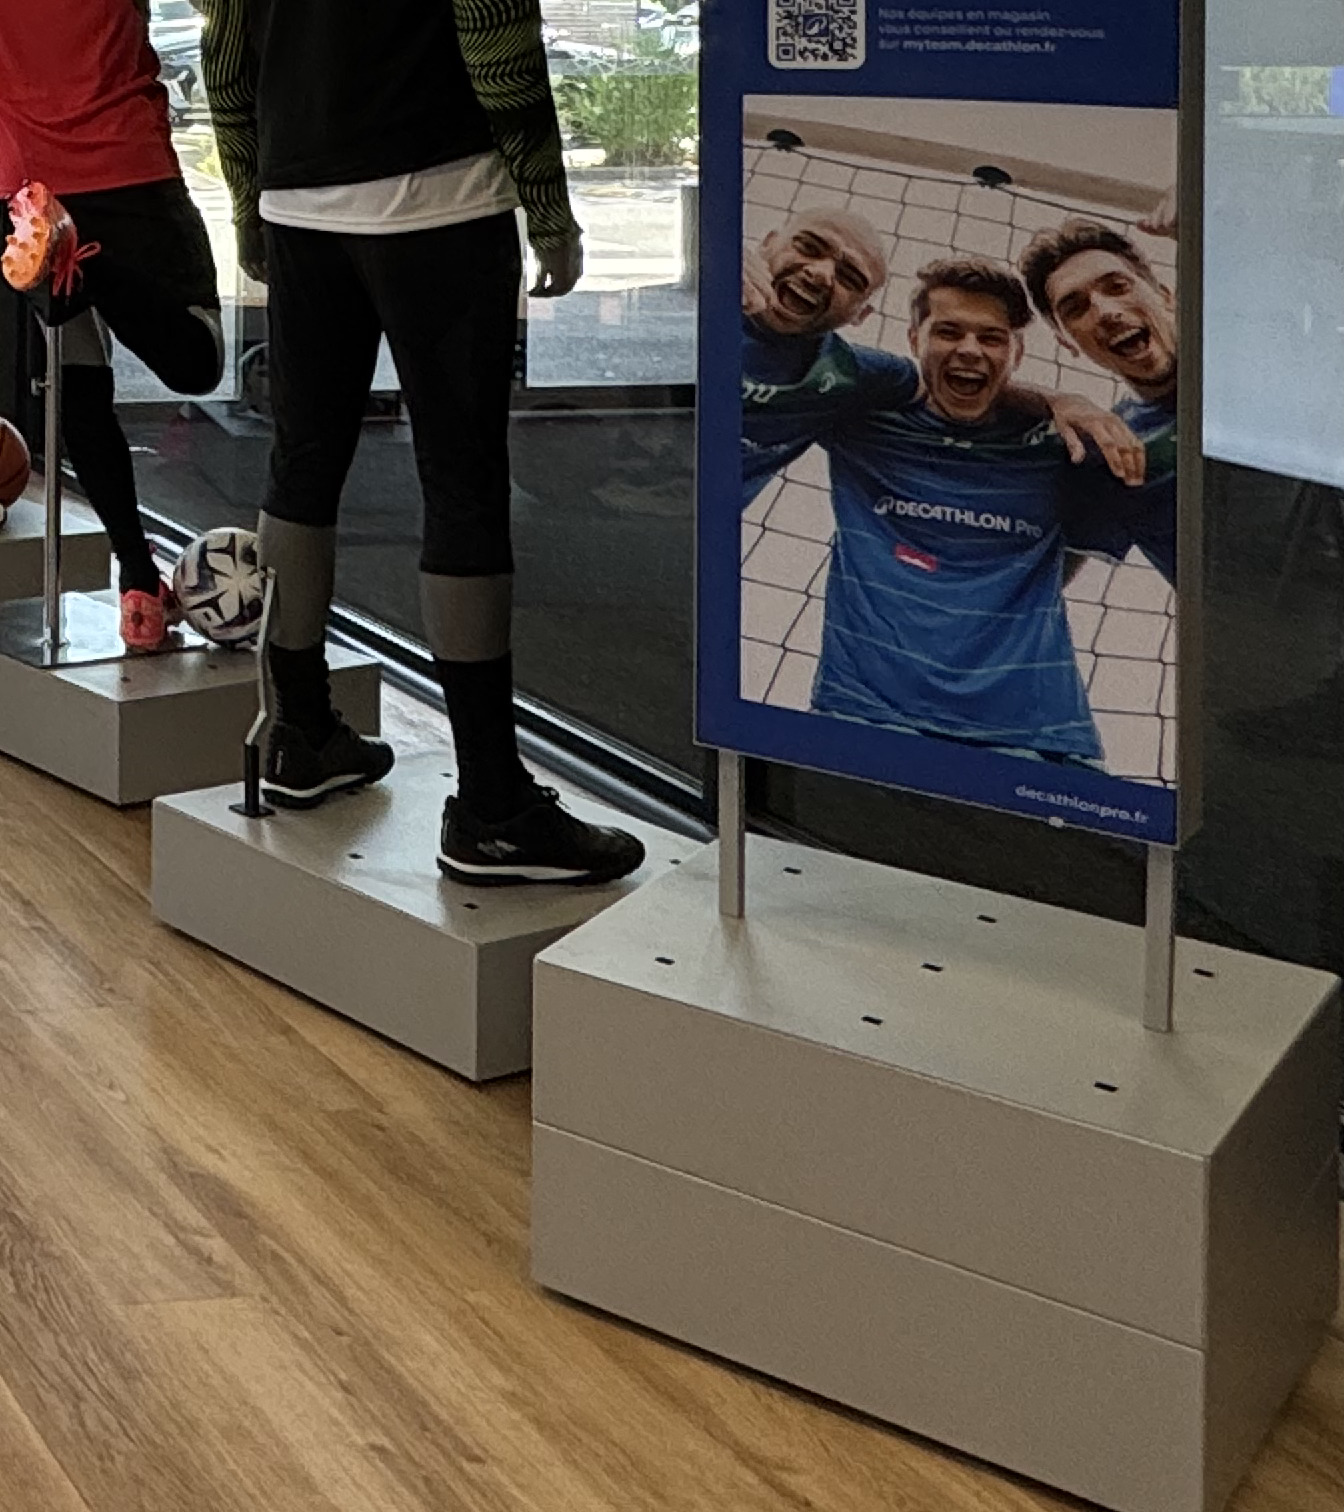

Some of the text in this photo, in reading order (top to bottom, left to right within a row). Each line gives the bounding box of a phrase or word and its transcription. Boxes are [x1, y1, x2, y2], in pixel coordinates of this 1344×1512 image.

[987, 8, 1051, 23] magasin
[902, 39, 1056, 53] myteam.decathlon.fr
[895, 500, 1044, 538] DECATHLON Pro
[1014, 784, 1149, 825] decathlonpro.fr
